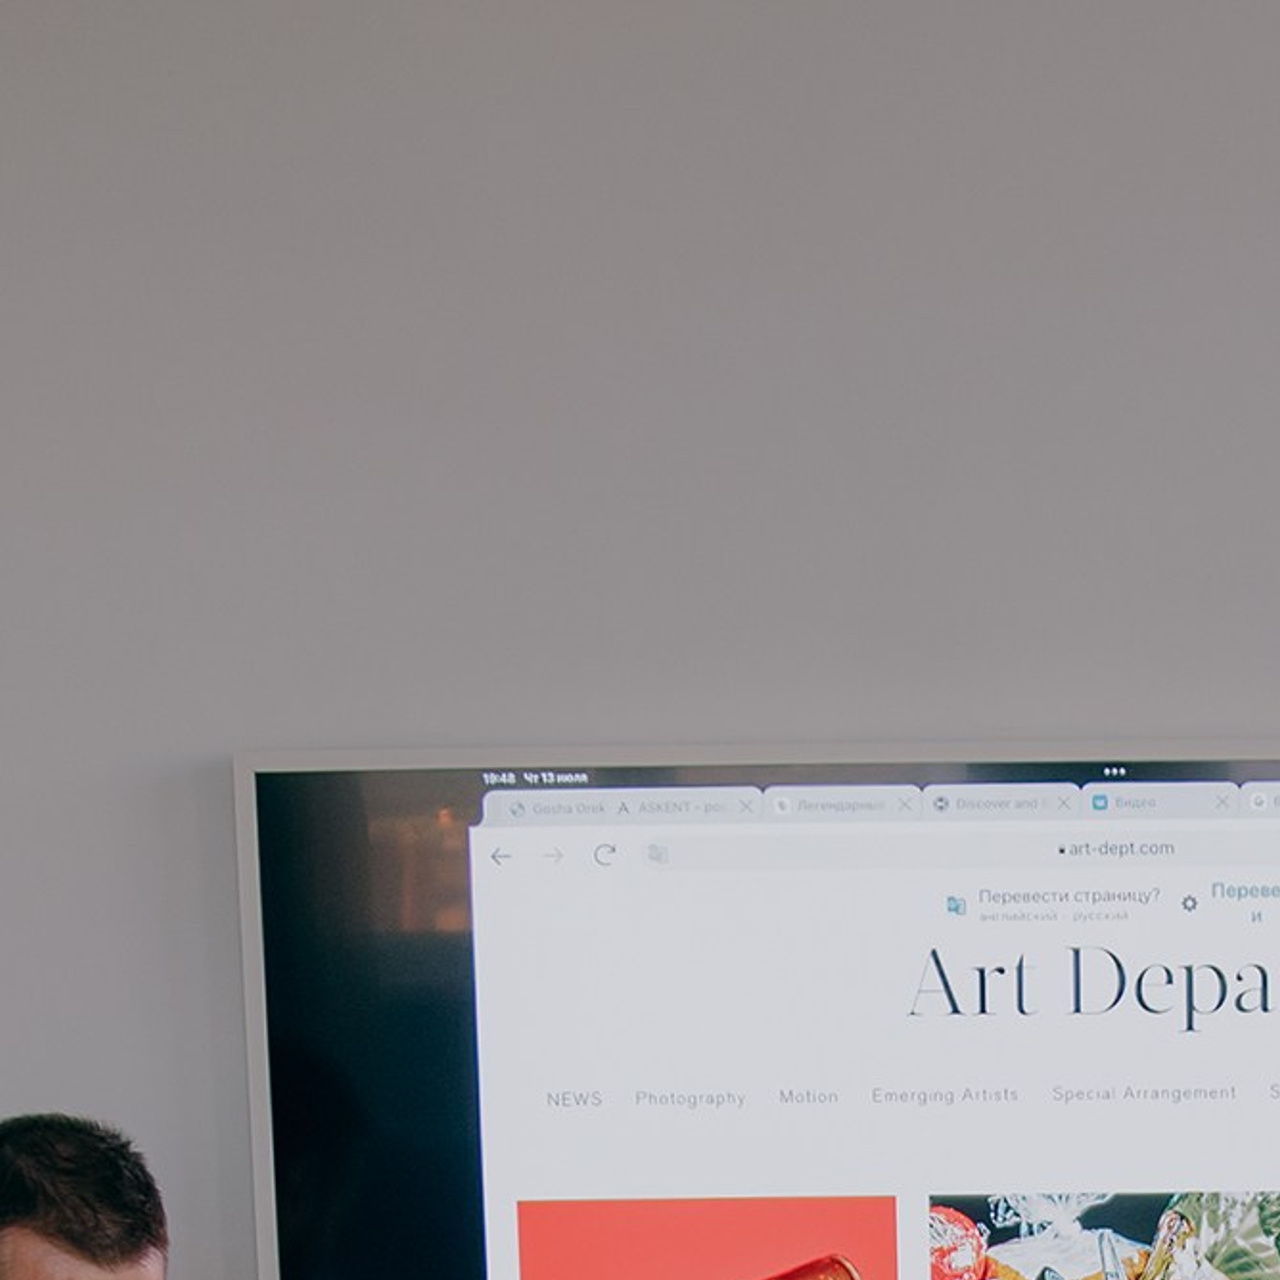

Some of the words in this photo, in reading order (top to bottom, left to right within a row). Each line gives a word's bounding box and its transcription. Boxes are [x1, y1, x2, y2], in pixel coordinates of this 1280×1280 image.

[1069, 841, 1175, 858] art-dept.com
[979, 889, 1069, 906] Перевести
[1073, 888, 1161, 905] страницу?
[907, 947, 1039, 1017] Art
[546, 1091, 603, 1107] NEWS
[635, 1090, 746, 1109] Photography
[779, 1089, 839, 1104] Motion
[871, 1087, 955, 1106] Emerging
[961, 1086, 1019, 1103] Artists
[1052, 1085, 1117, 1104] Special
[1123, 1085, 1237, 1103] Arrangement
